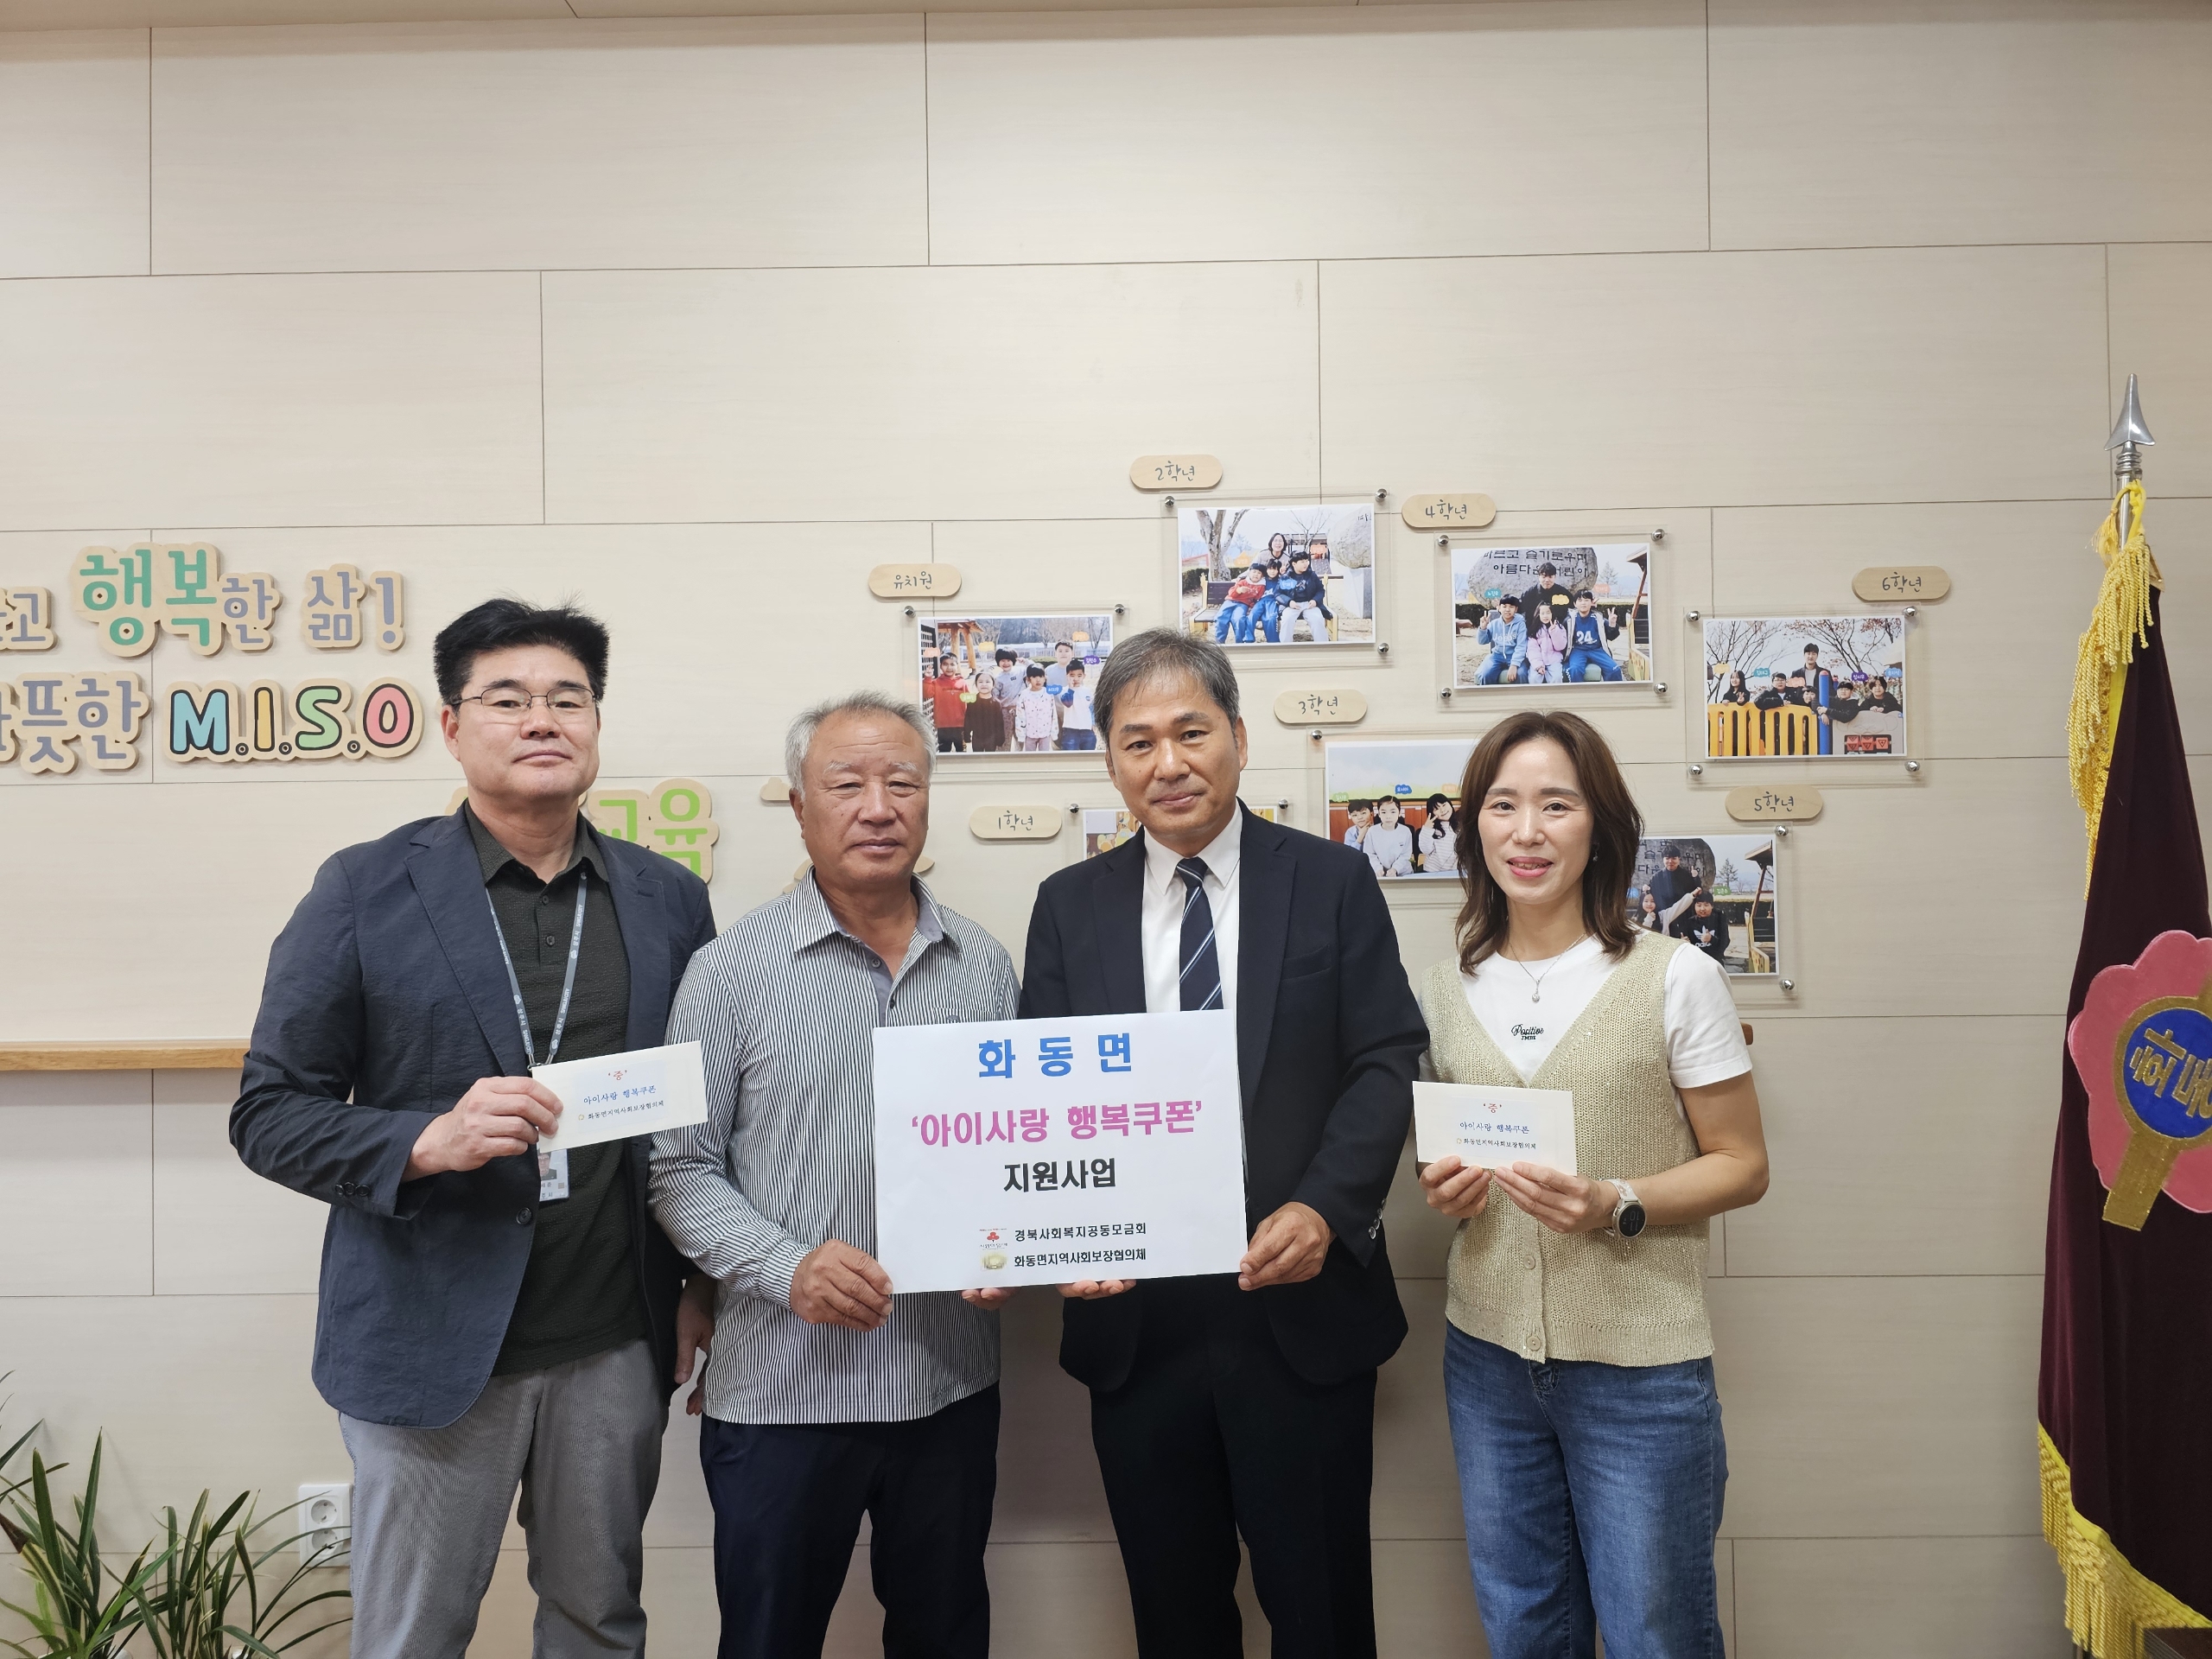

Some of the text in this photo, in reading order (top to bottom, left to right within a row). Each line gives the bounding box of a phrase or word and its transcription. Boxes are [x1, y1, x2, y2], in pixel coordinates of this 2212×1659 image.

[1154, 461, 1196, 481] 2학년
[1425, 499, 1467, 522] 4학년
[893, 572, 934, 591] 유치원
[1881, 571, 1923, 594] 6학년
[0, 549, 395, 646] 고 행복한 삶!
[1298, 696, 1340, 716] 3학년
[0, 678, 415, 763] 뜻한 M.I.S.O
[1753, 790, 1796, 812] 5학년
[997, 810, 1035, 831] 1학년
[583, 1084, 657, 1105] 아이사랑 행복쿠폰
[1459, 1122, 1529, 1135] 아이사랑 행복쿠폰
[1003, 1158, 1116, 1192] 지원사업
[1014, 1222, 1147, 1242] 경북사회복지공동모금회
[1014, 1248, 1147, 1268] 화동면지역사회보장협의체
